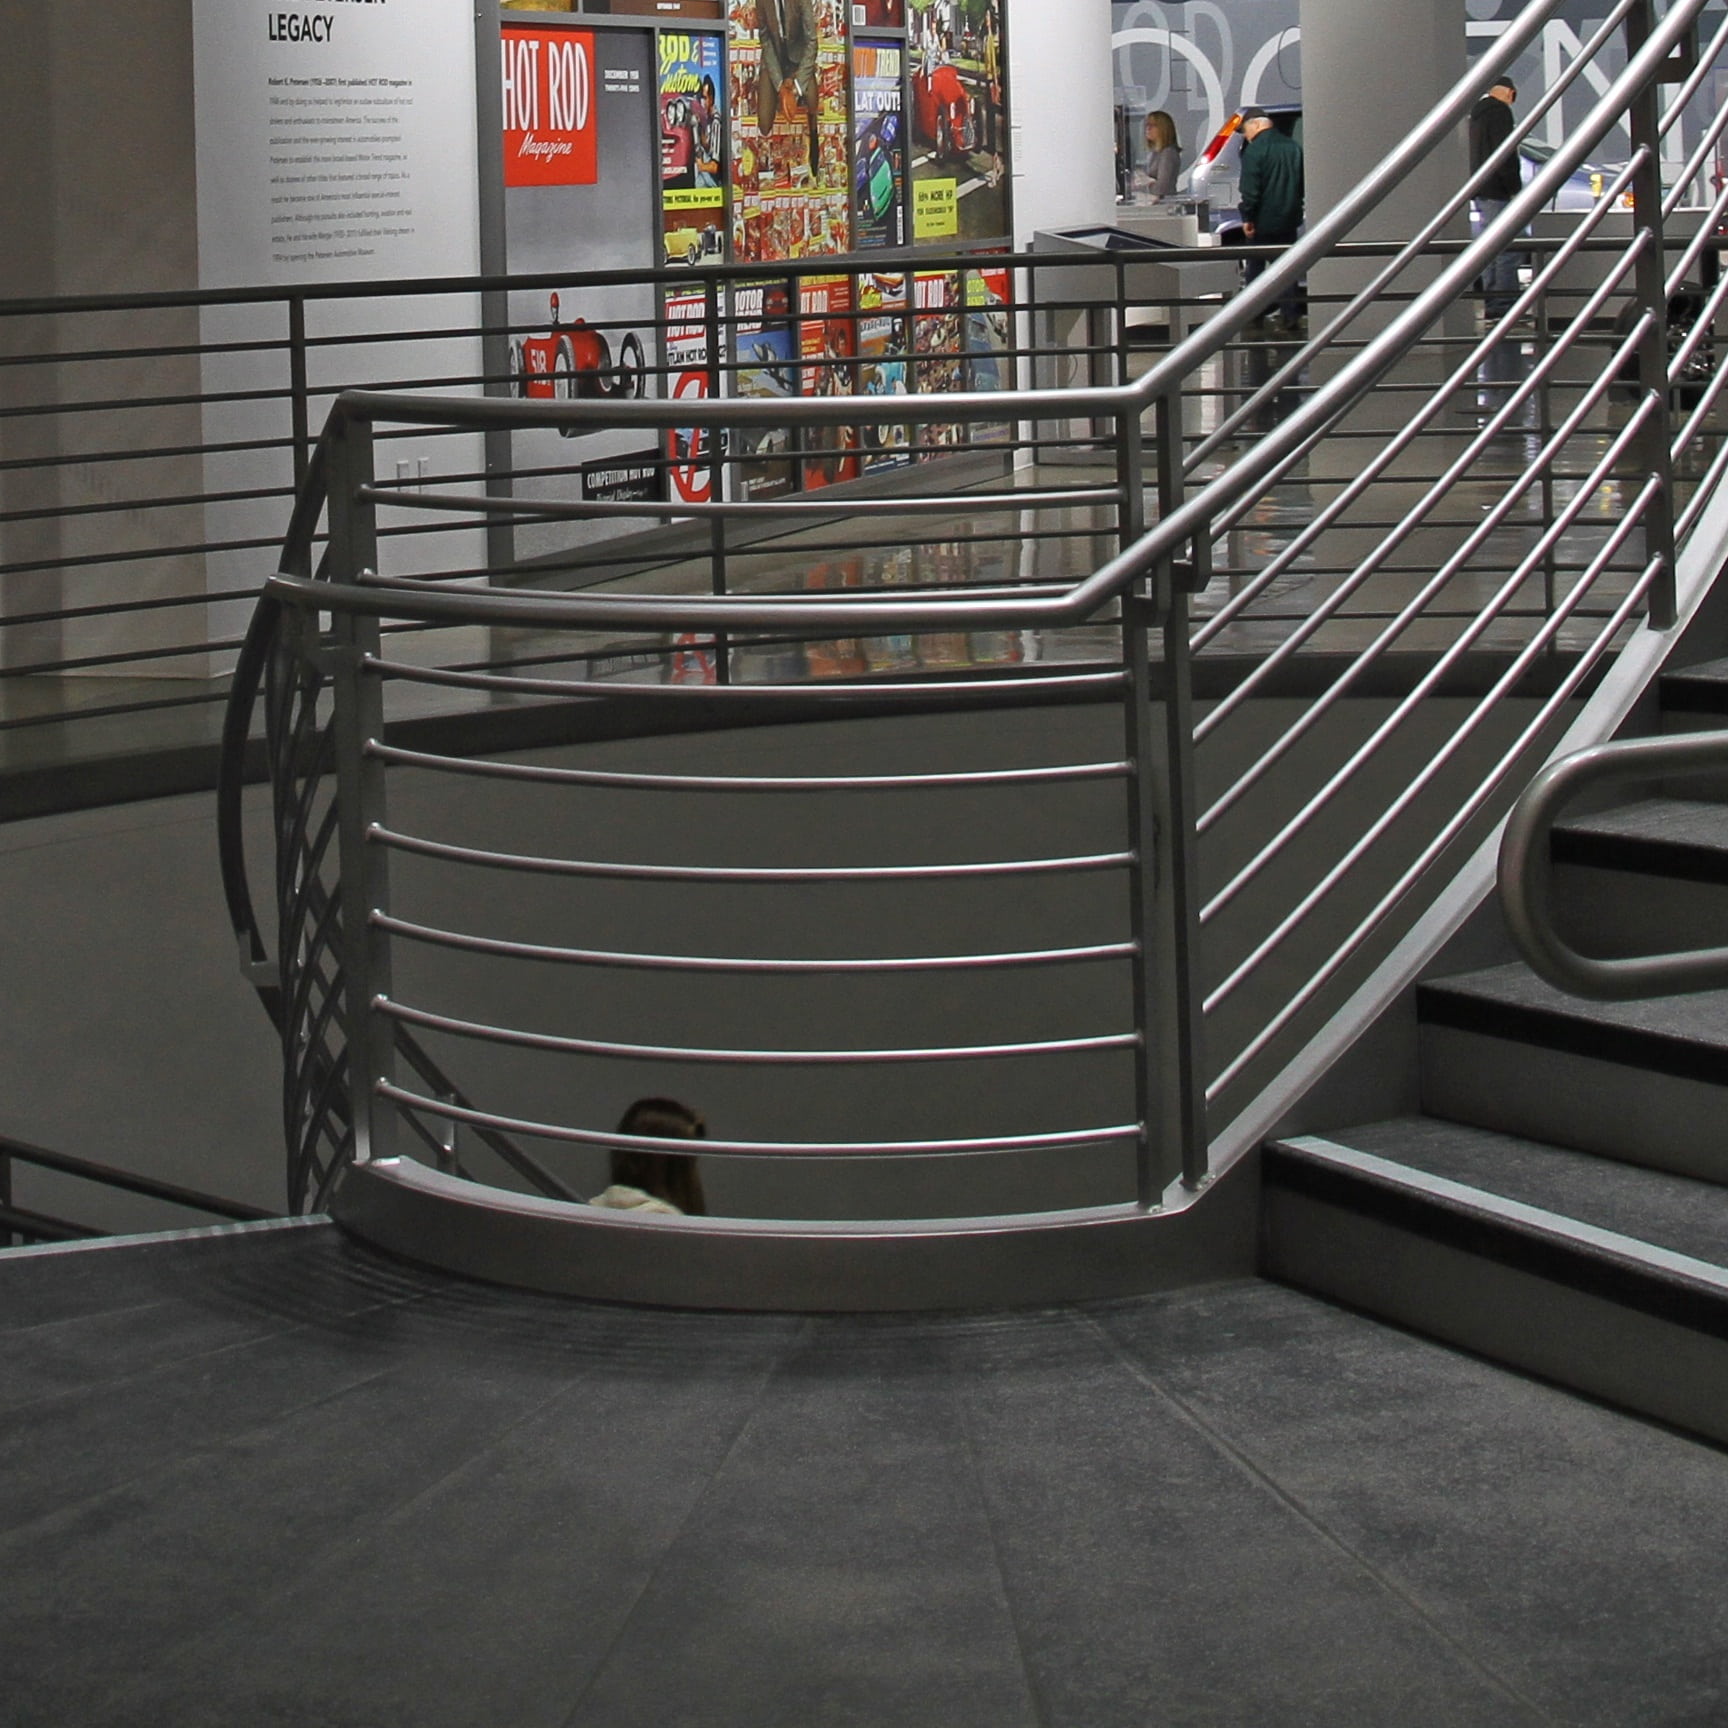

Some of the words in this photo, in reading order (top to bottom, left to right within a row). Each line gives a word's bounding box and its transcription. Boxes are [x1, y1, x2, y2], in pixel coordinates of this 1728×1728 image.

[268, 13, 334, 42] LEGACY
[501, 39, 539, 131] HOT
[548, 41, 589, 131] ROD
[854, 91, 874, 112] LAT
[877, 91, 901, 112] OUT!
[518, 131, 572, 163] Magazine
